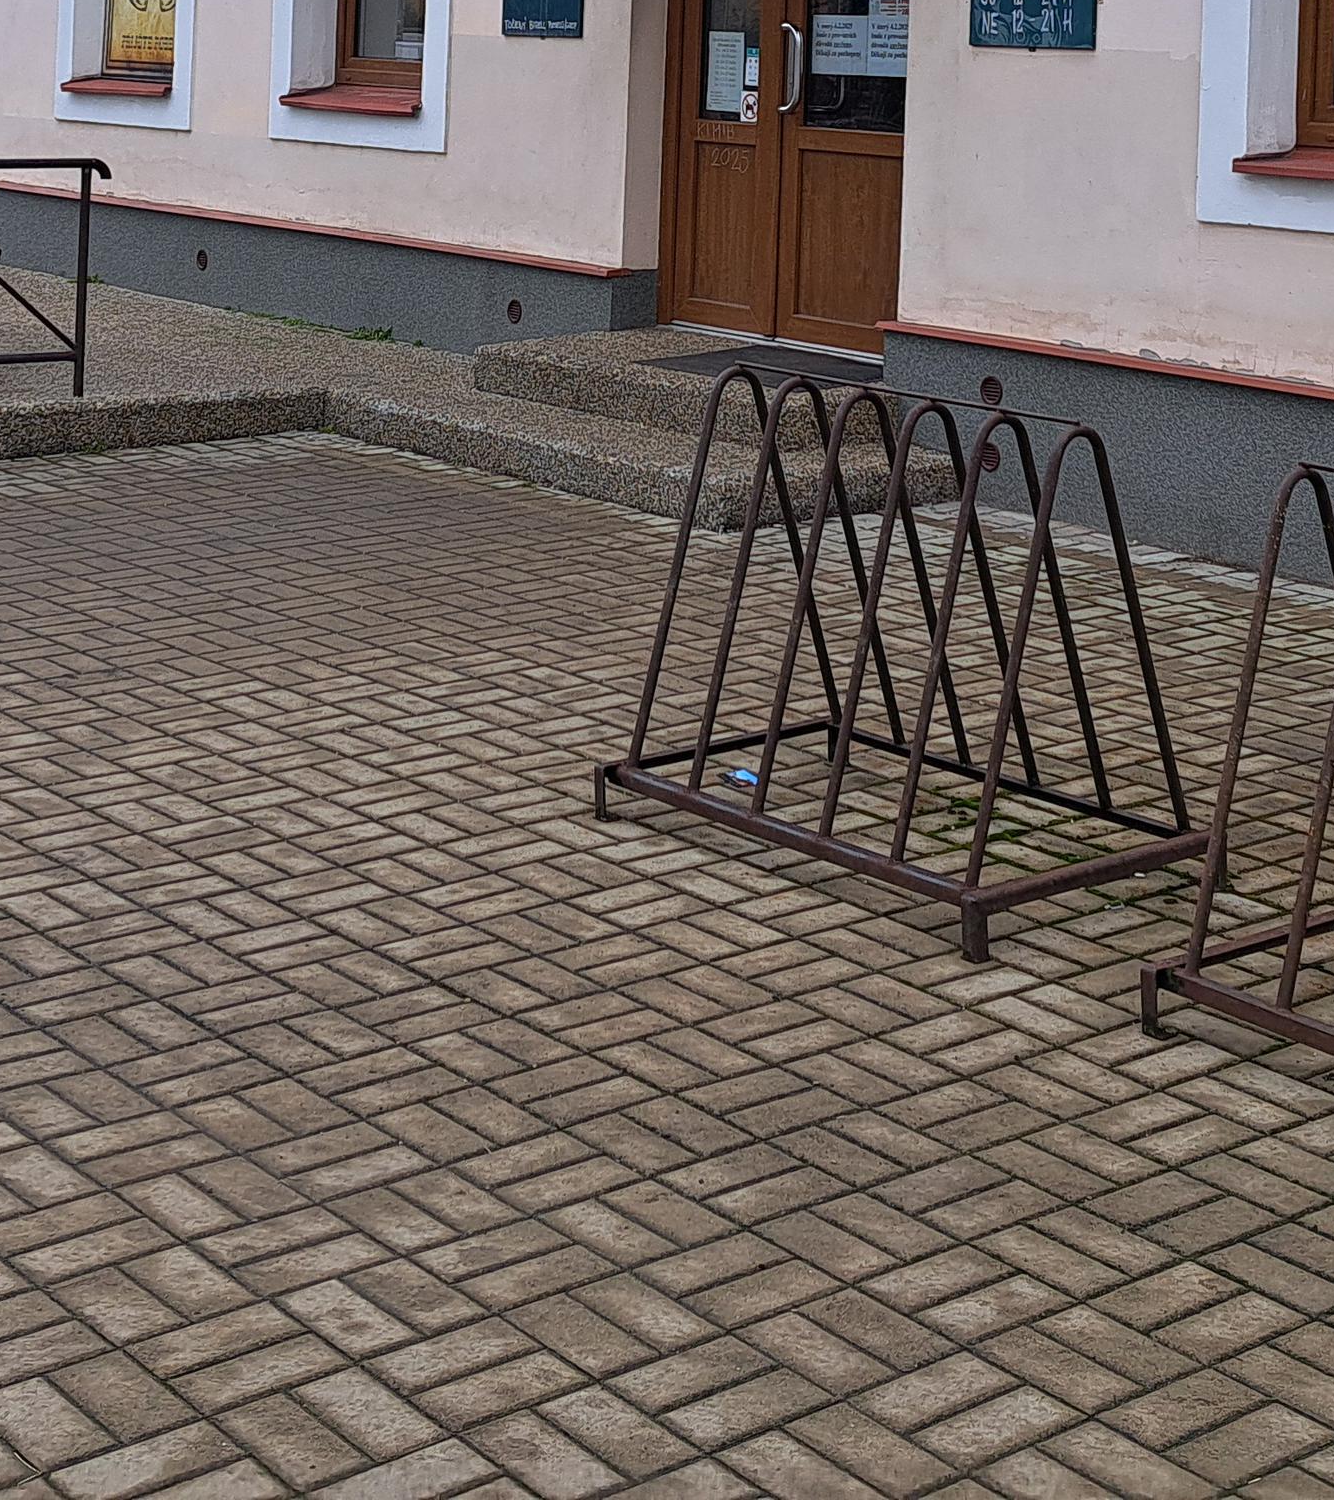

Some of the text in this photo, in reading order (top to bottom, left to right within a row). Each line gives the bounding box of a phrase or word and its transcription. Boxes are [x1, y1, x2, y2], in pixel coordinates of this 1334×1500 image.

[982, 10, 1000, 35] NE
[1012, 9, 1024, 34] 12
[1040, 8, 1055, 32] 21
[1063, 8, 1073, 35] H
[711, 147, 750, 174] 2025
